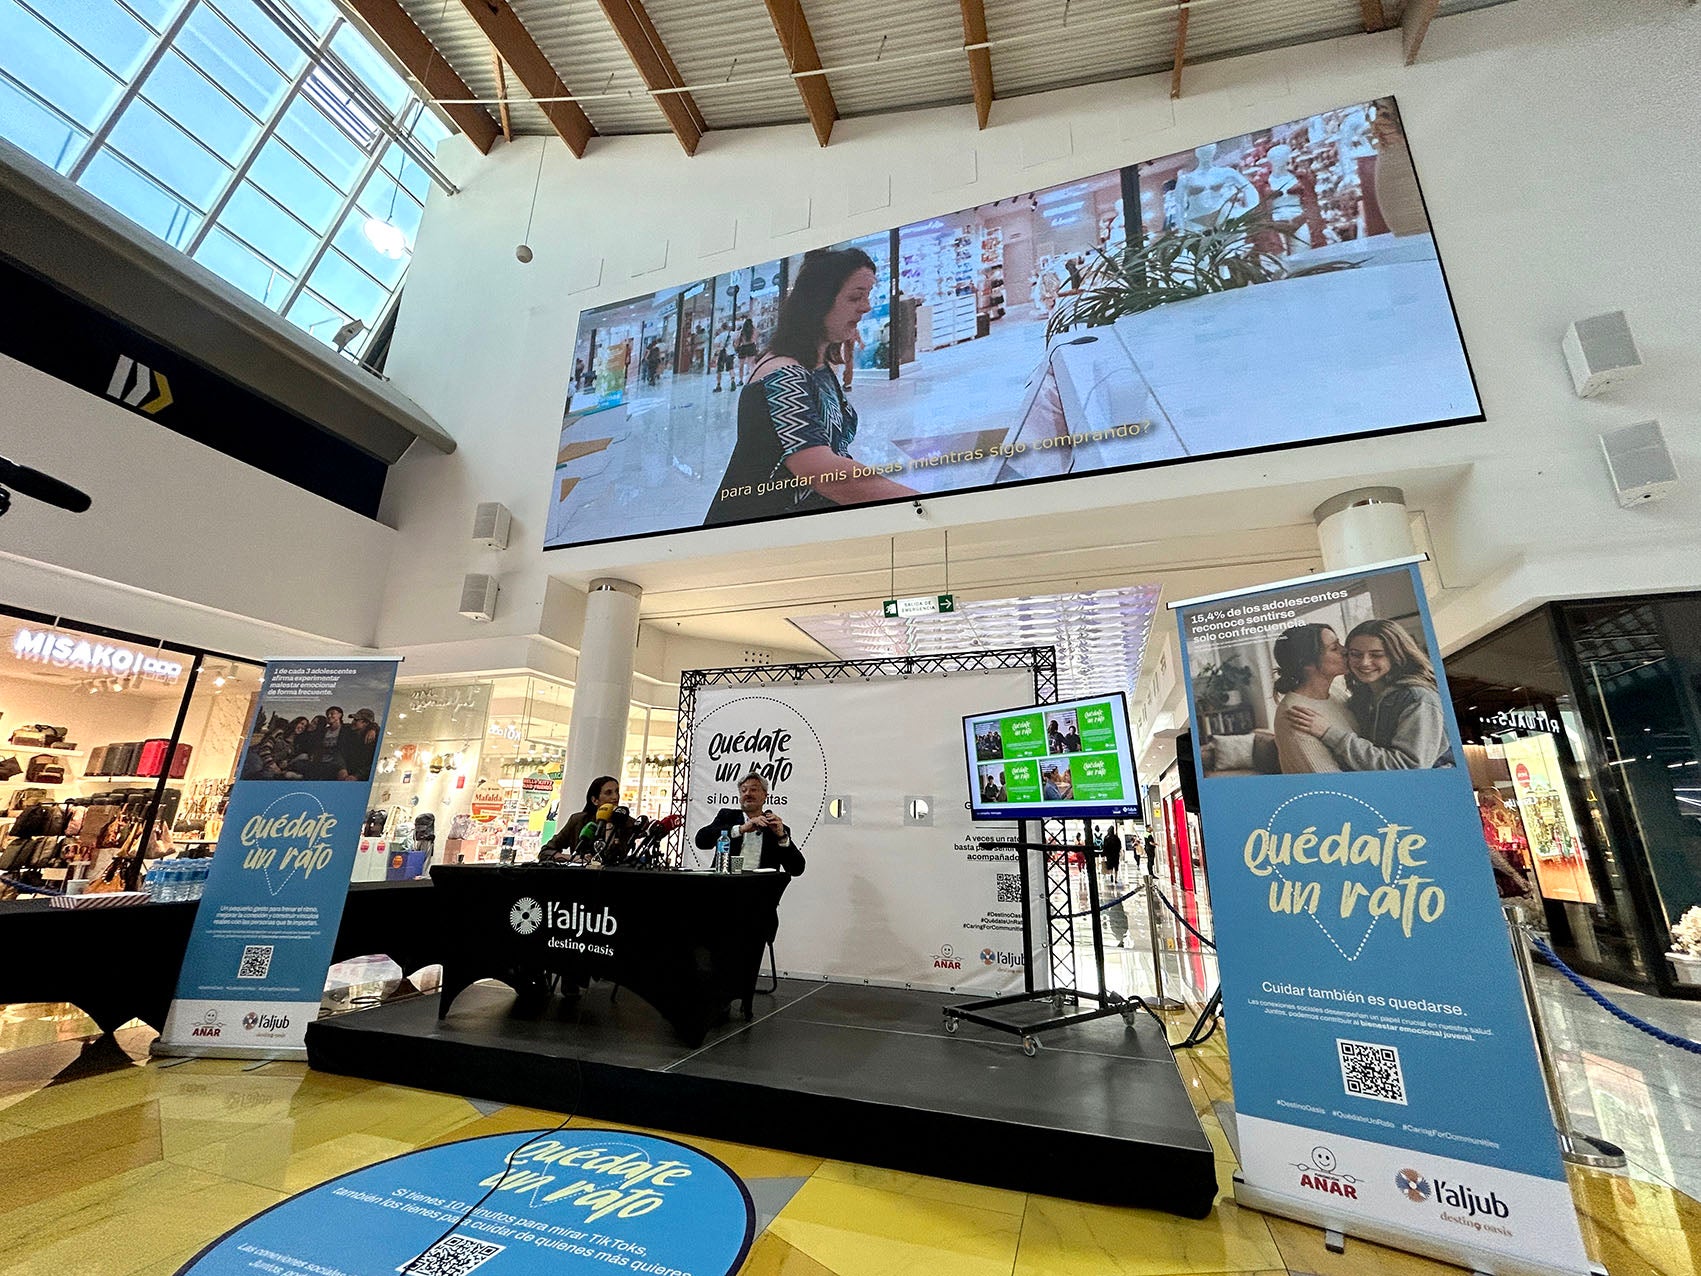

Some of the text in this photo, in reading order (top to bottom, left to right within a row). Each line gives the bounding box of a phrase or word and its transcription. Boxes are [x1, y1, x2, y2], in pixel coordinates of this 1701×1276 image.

[720, 420, 1151, 501] para guardar mis bolsas mientras sigo comprando?
[1191, 589, 1348, 624] 15,4% de los adolescentes
[1191, 609, 1296, 634] reconoce sentirse
[1192, 632, 1217, 645] solo
[1218, 629, 1240, 640] con
[1241, 619, 1307, 636] frecuencia
[14, 629, 134, 671] MISAKO
[294, 675, 340, 683] experimentar
[708, 727, 792, 762] Quédate
[715, 756, 793, 792] un rato
[706, 793, 788, 806] si lo nitas
[241, 811, 338, 848] Quédate
[954, 843, 975, 851] basta
[243, 842, 333, 880] un rato
[1243, 821, 1428, 884] Quédate
[547, 901, 618, 938] l'aljub
[981, 917, 1023, 925] #QuédateUnRat
[987, 911, 1022, 919] #DestinoOas
[1268, 874, 1446, 939] un rato
[963, 923, 1023, 932] #CaringForCommunitie
[547, 936, 615, 957] destino oasis
[933, 960, 961, 970] ANAR
[1247, 998, 1260, 1006] Las
[1259, 1000, 1296, 1010] conexiones
[1296, 1003, 1324, 1014] sociales
[1379, 1015, 1401, 1025] papel
[1401, 1018, 1427, 1027] crucial
[1438, 1023, 1469, 1033] nuestra
[1261, 981, 1468, 1017] Cuidar también es quedarse.
[192, 1027, 221, 1037] ANAR
[258, 1014, 290, 1032] l'aljub
[1288, 1010, 1319, 1021] podemos
[1319, 1014, 1353, 1025] contribuir
[1360, 1020, 1399, 1031] bienestar
[1399, 1025, 1443, 1037] emocional
[504, 1140, 693, 1190] Quédate
[478, 1169, 665, 1224] un rato
[1300, 1174, 1358, 1200] ANAR
[1433, 1178, 1510, 1219] l'aljub
[331, 1186, 692, 1276] también los tienes para cuidar de quienes más quieres
[391, 1188, 647, 1257] Si tienes 10 minutos para mirar TikToks,
[1440, 1211, 1513, 1237] destino oasis
